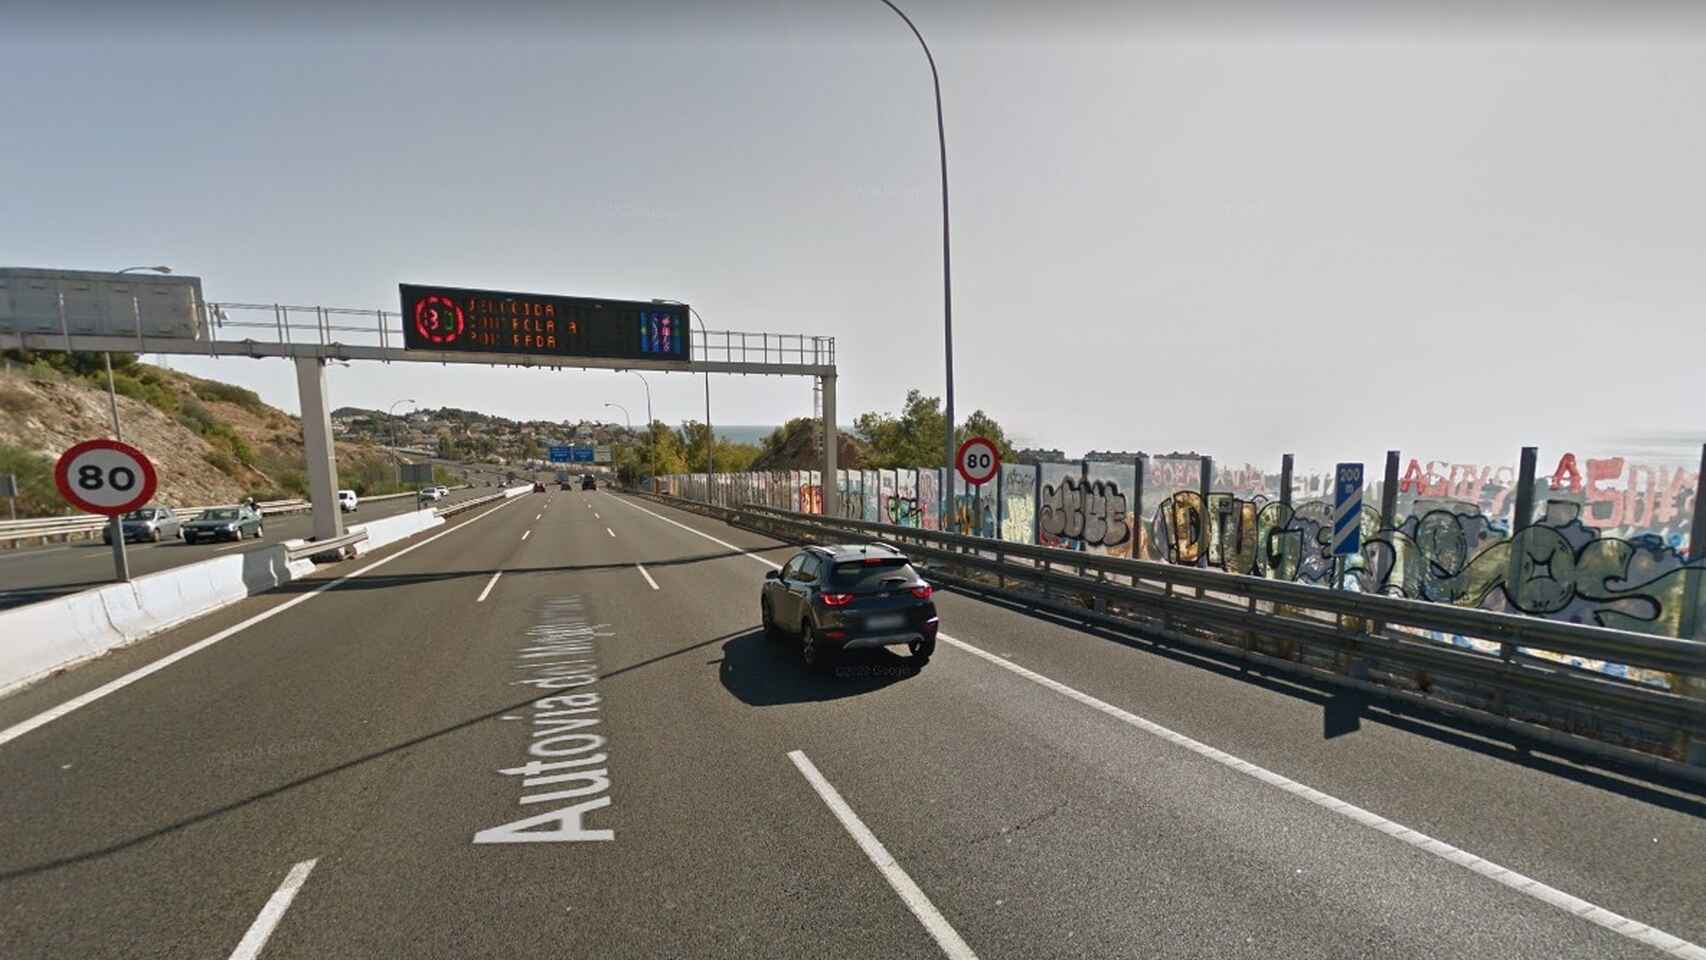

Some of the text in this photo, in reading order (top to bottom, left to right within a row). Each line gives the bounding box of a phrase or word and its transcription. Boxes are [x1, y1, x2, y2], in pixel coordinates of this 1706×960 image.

[967, 454, 990, 469] 80
[78, 465, 135, 491] 80
[1340, 468, 1361, 481] 200
